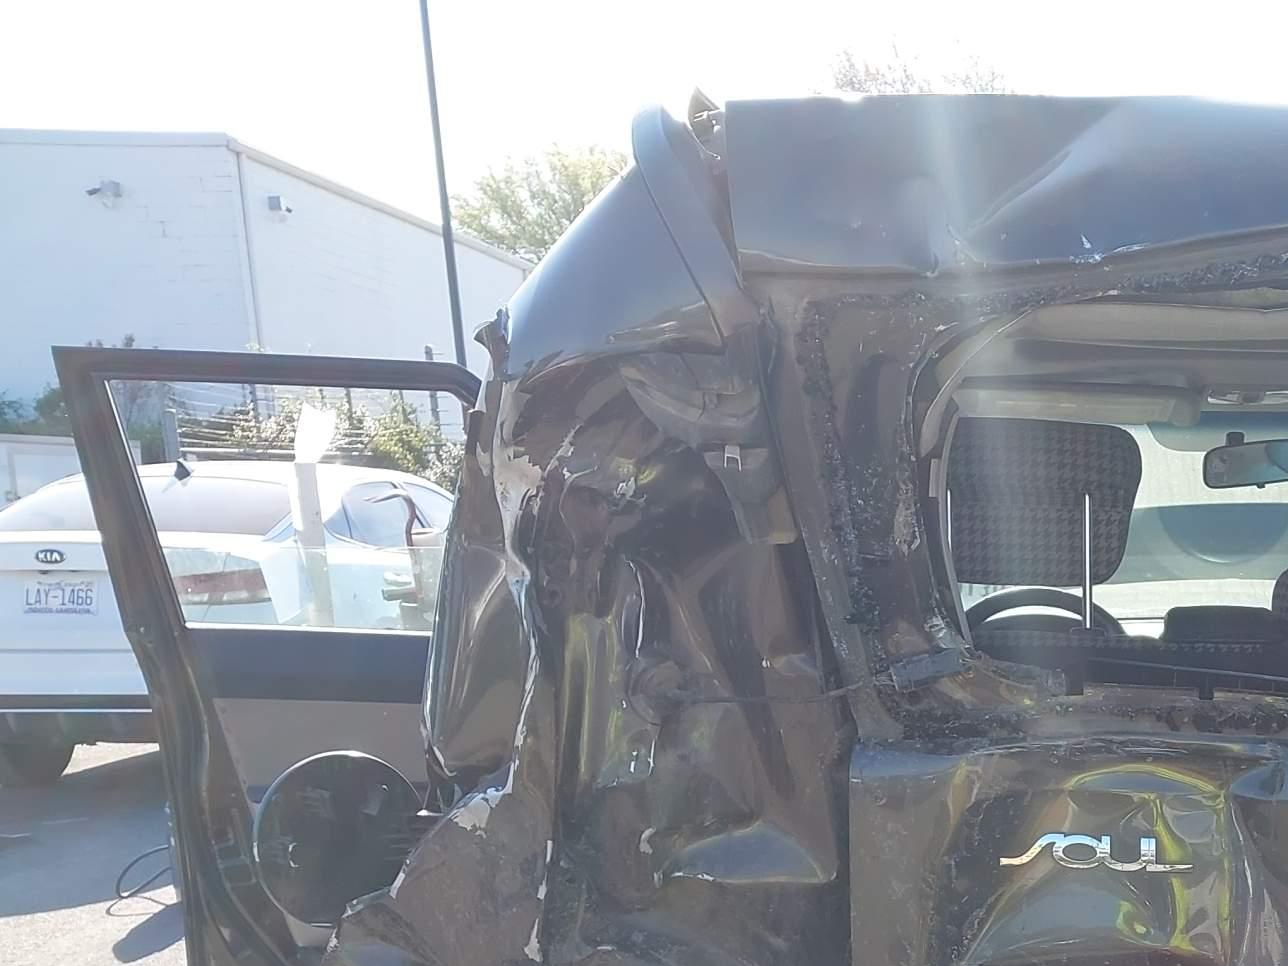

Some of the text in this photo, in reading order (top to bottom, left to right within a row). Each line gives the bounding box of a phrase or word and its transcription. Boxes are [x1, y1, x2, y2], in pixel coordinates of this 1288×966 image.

[38, 551, 61, 562] KIA
[25, 588, 93, 606] LAY-1466
[999, 833, 1194, 872] SOUL
